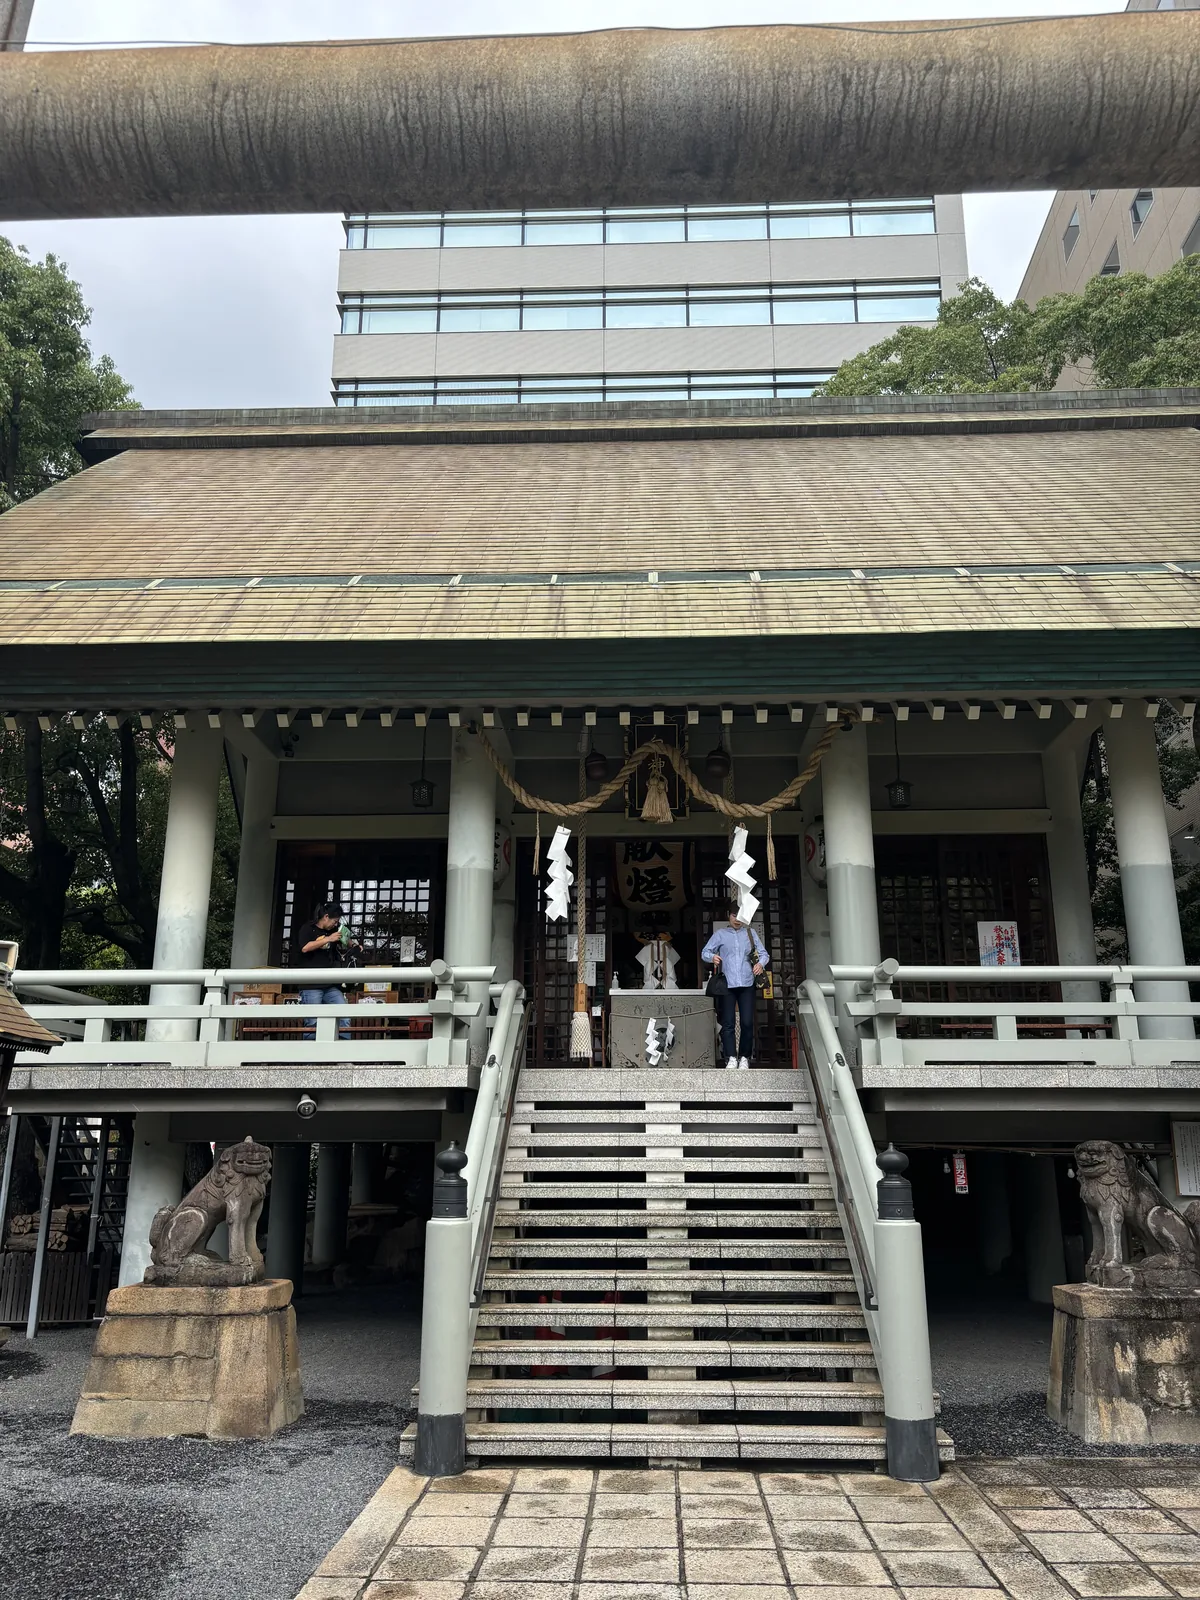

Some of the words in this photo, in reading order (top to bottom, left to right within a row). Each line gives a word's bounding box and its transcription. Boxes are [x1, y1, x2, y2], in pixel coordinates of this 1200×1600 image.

[993, 925, 1006, 966] 秋季例大祭
